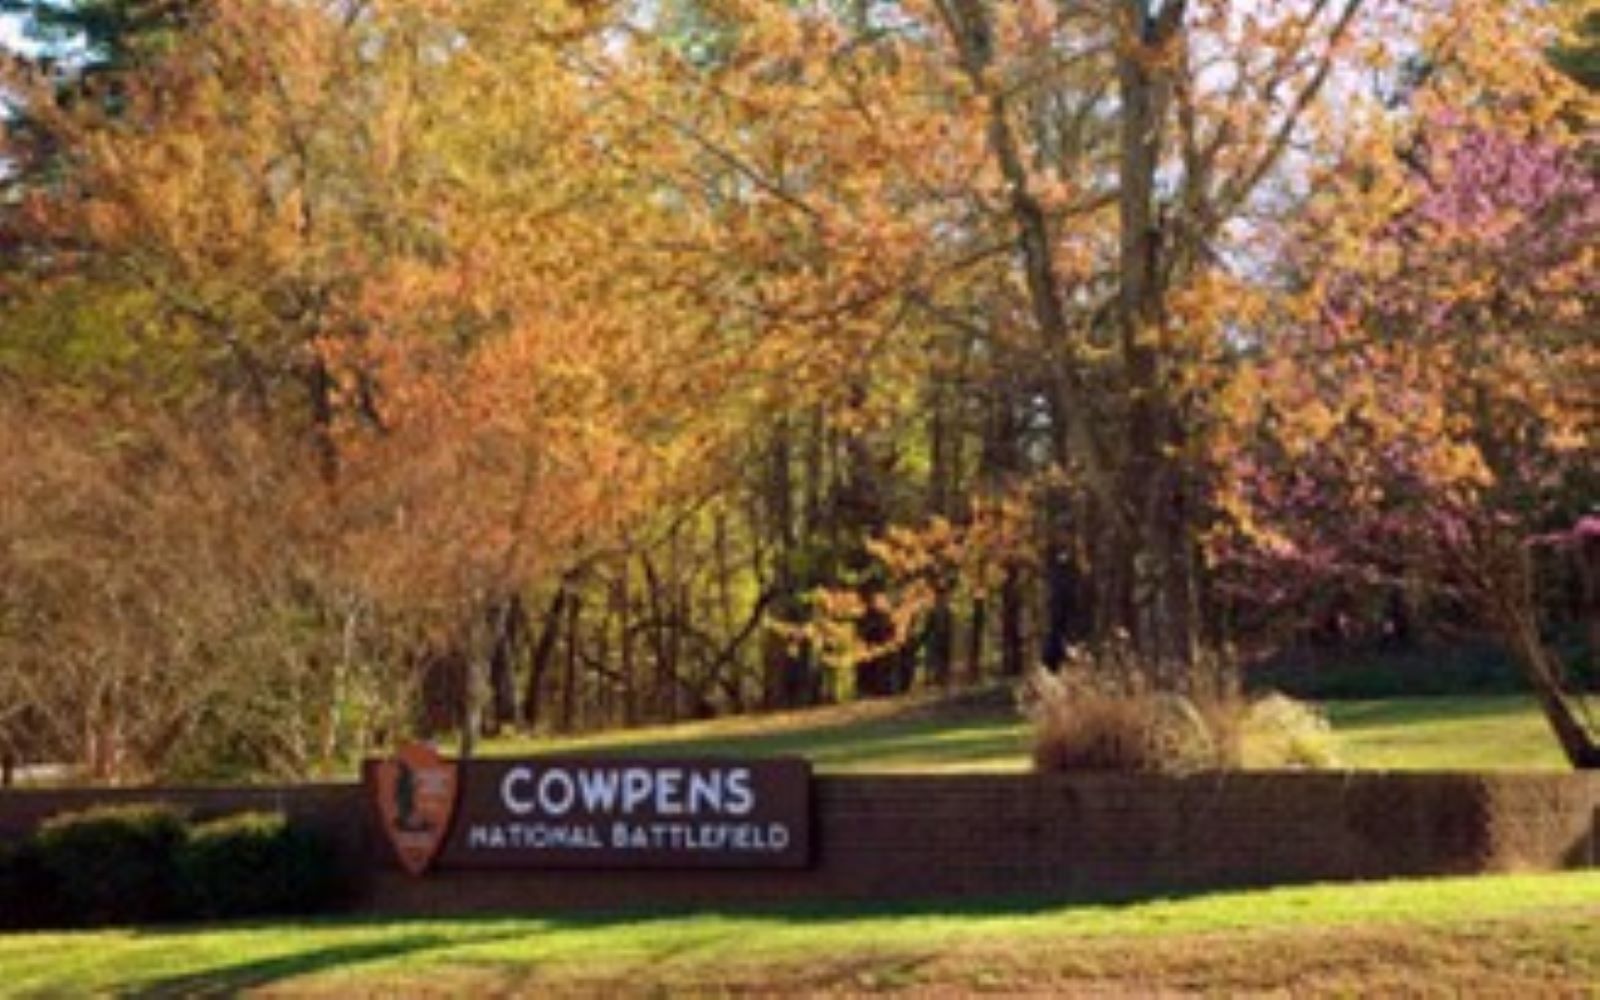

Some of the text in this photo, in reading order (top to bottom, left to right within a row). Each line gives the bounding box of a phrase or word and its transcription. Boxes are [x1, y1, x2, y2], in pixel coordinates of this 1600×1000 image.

[501, 767, 755, 814] COWPENS
[469, 822, 790, 849] NATIONAL BATTLEFIELD
